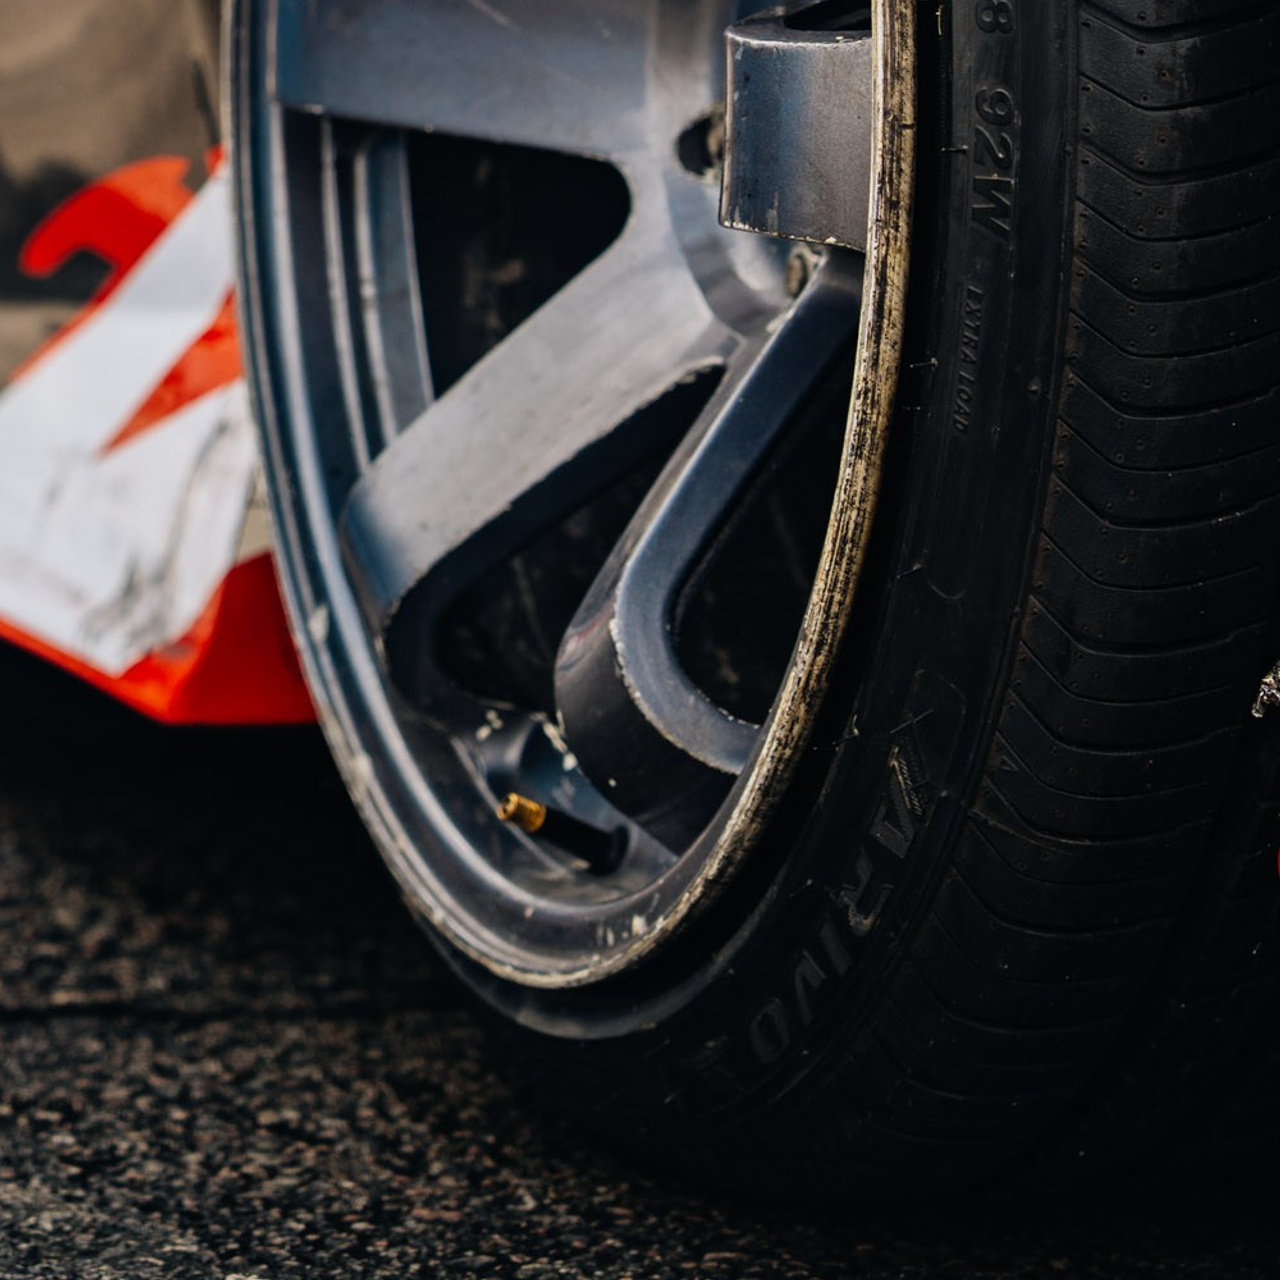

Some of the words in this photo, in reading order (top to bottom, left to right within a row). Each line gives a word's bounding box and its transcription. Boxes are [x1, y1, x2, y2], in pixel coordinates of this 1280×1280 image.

[970, 85, 1016, 243] 92W
[959, 284, 984, 364] EXTRA
[952, 370, 976, 432] LOAD
